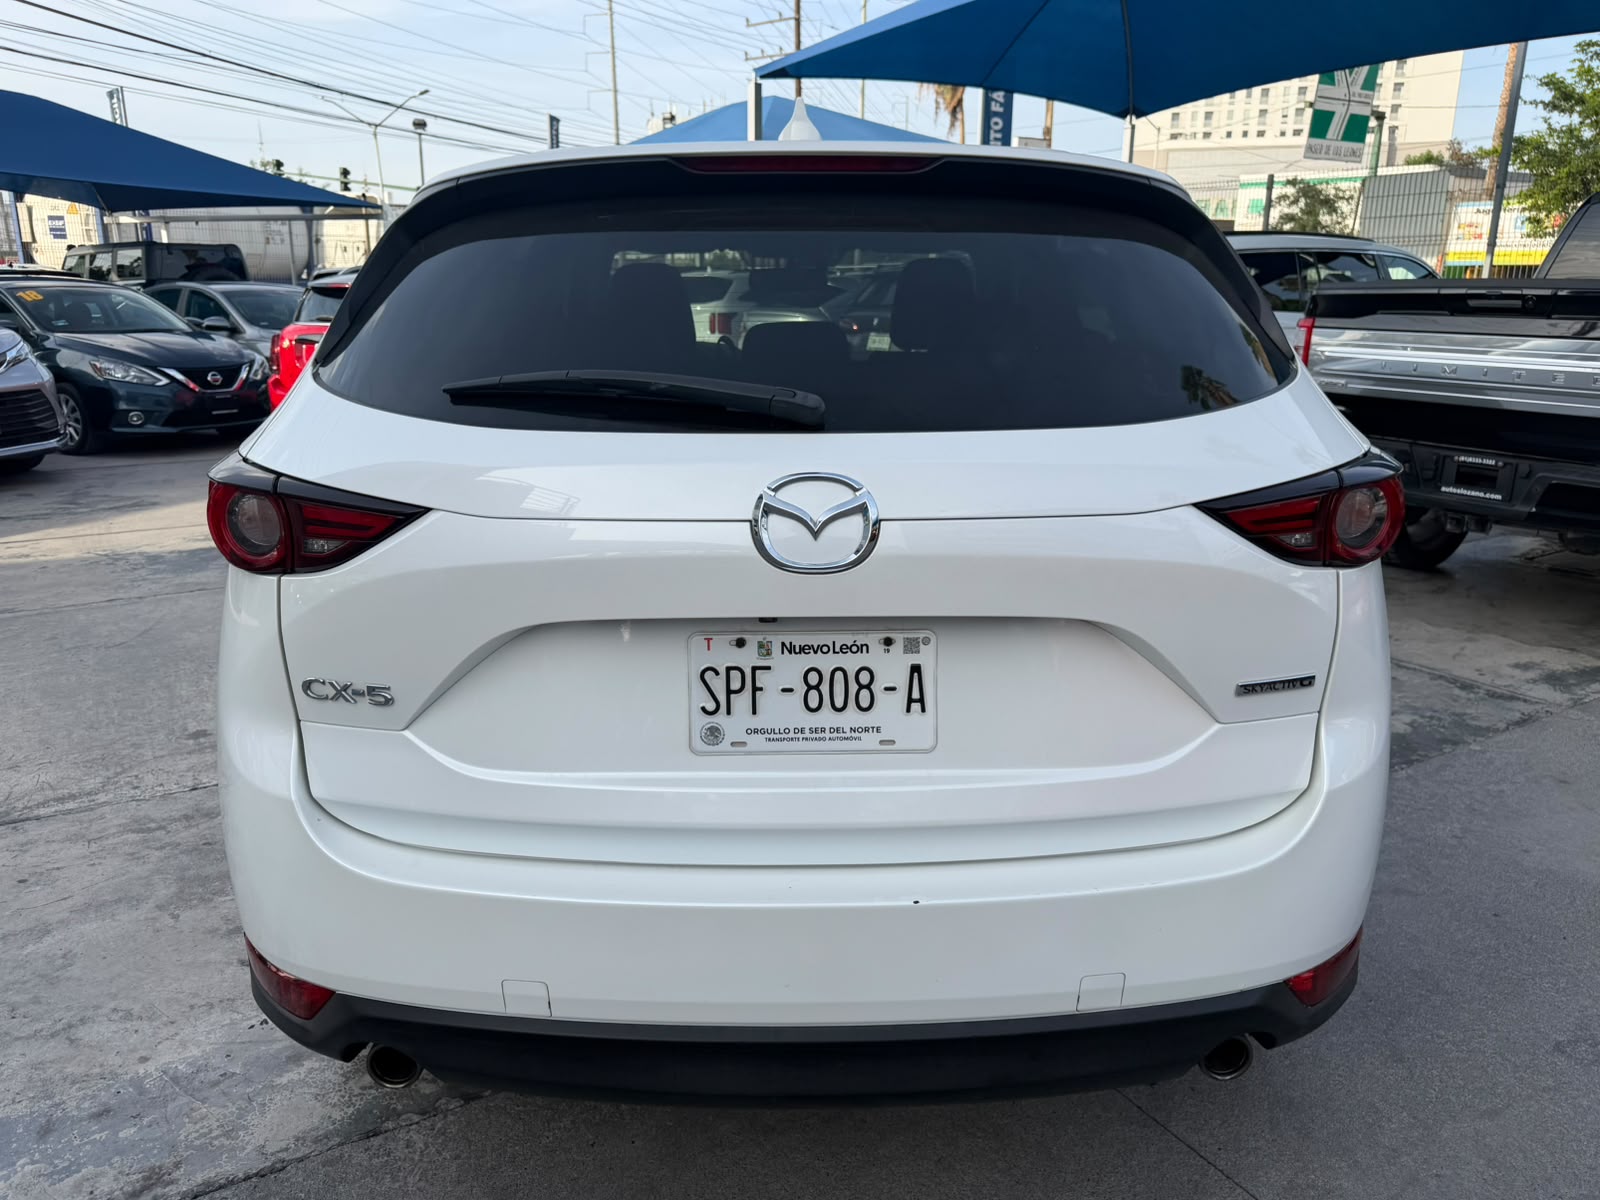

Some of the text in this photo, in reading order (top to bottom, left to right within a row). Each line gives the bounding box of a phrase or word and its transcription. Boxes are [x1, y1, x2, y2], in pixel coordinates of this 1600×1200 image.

[703, 637, 714, 652] T
[780, 640, 870, 655] Nuevo León
[301, 677, 396, 706] CX-5
[699, 663, 927, 717] SPF-808-A
[745, 725, 882, 735] ORGULLO DE SER DEL NORTE
[828, 734, 862, 742] AUTOMÓVIL
